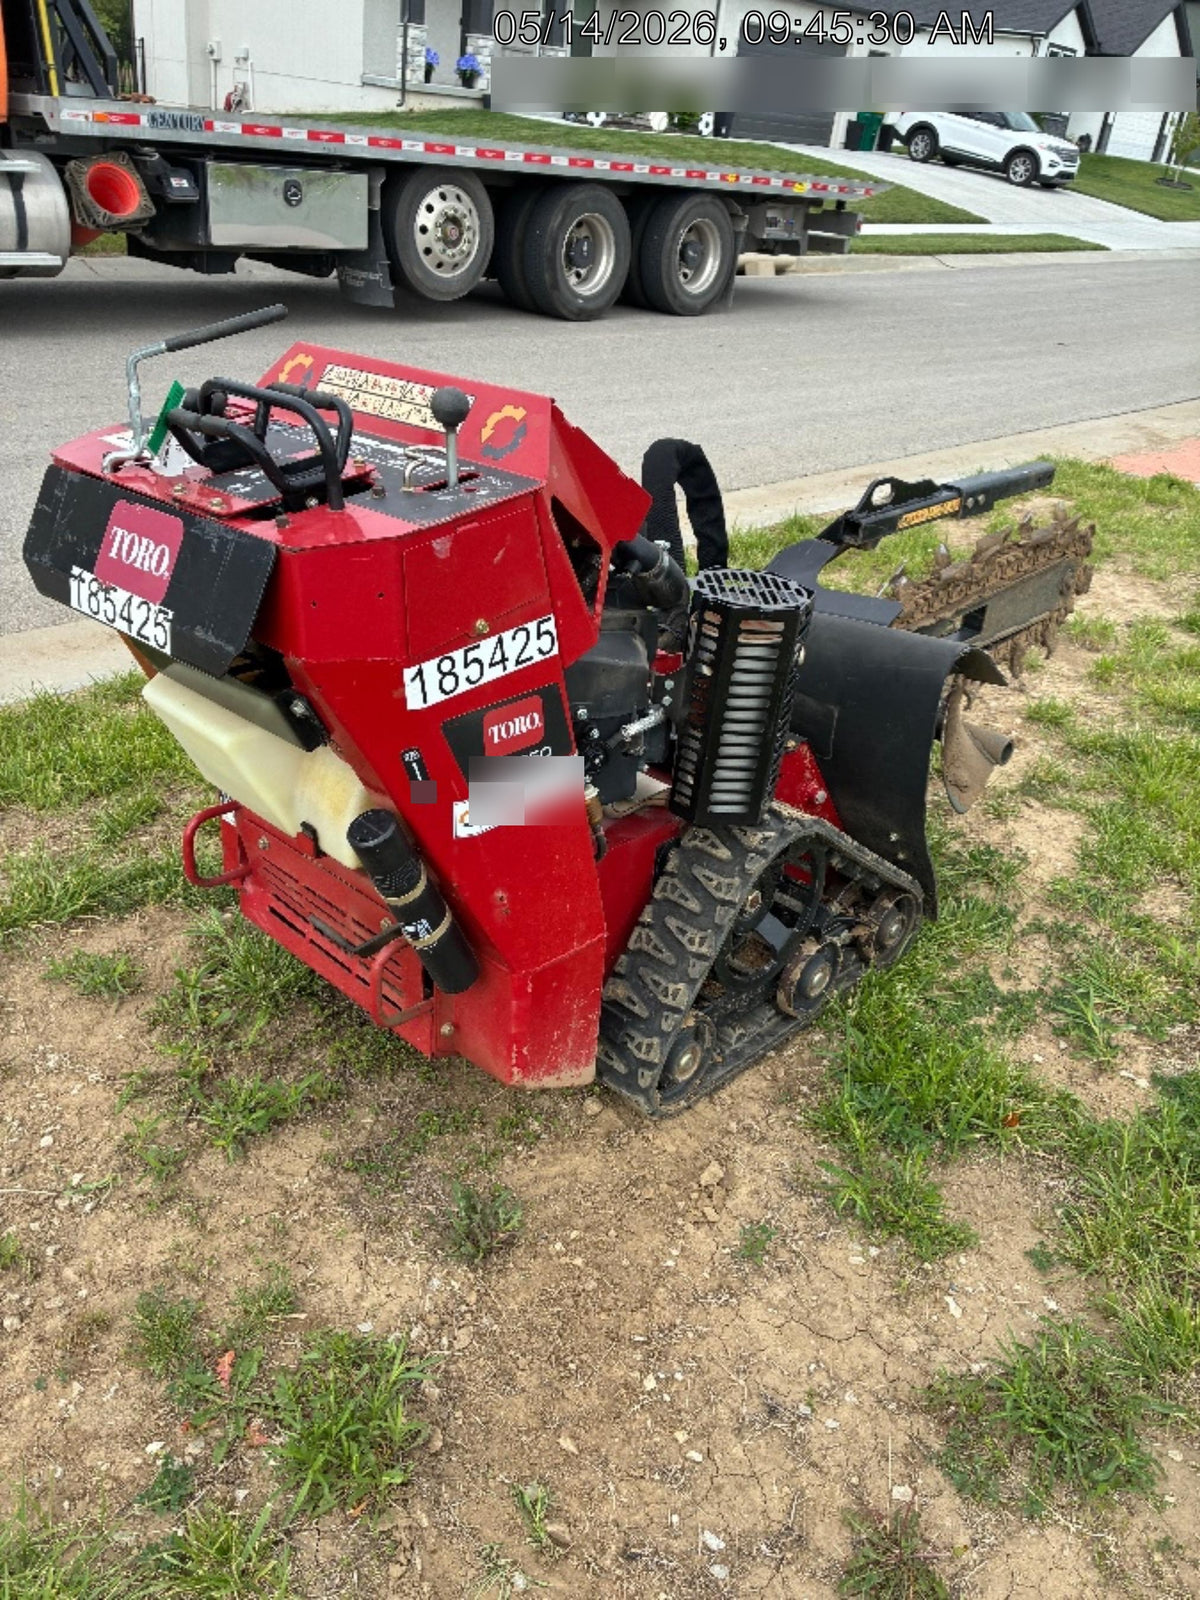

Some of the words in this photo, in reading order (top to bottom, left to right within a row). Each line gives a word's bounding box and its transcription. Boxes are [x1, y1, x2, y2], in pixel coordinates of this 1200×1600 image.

[147, 110, 206, 133] CENTUR
[108, 526, 170, 578] TORO
[70, 570, 174, 650] 185425
[409, 616, 556, 704] 185425
[488, 712, 544, 744] TORO
